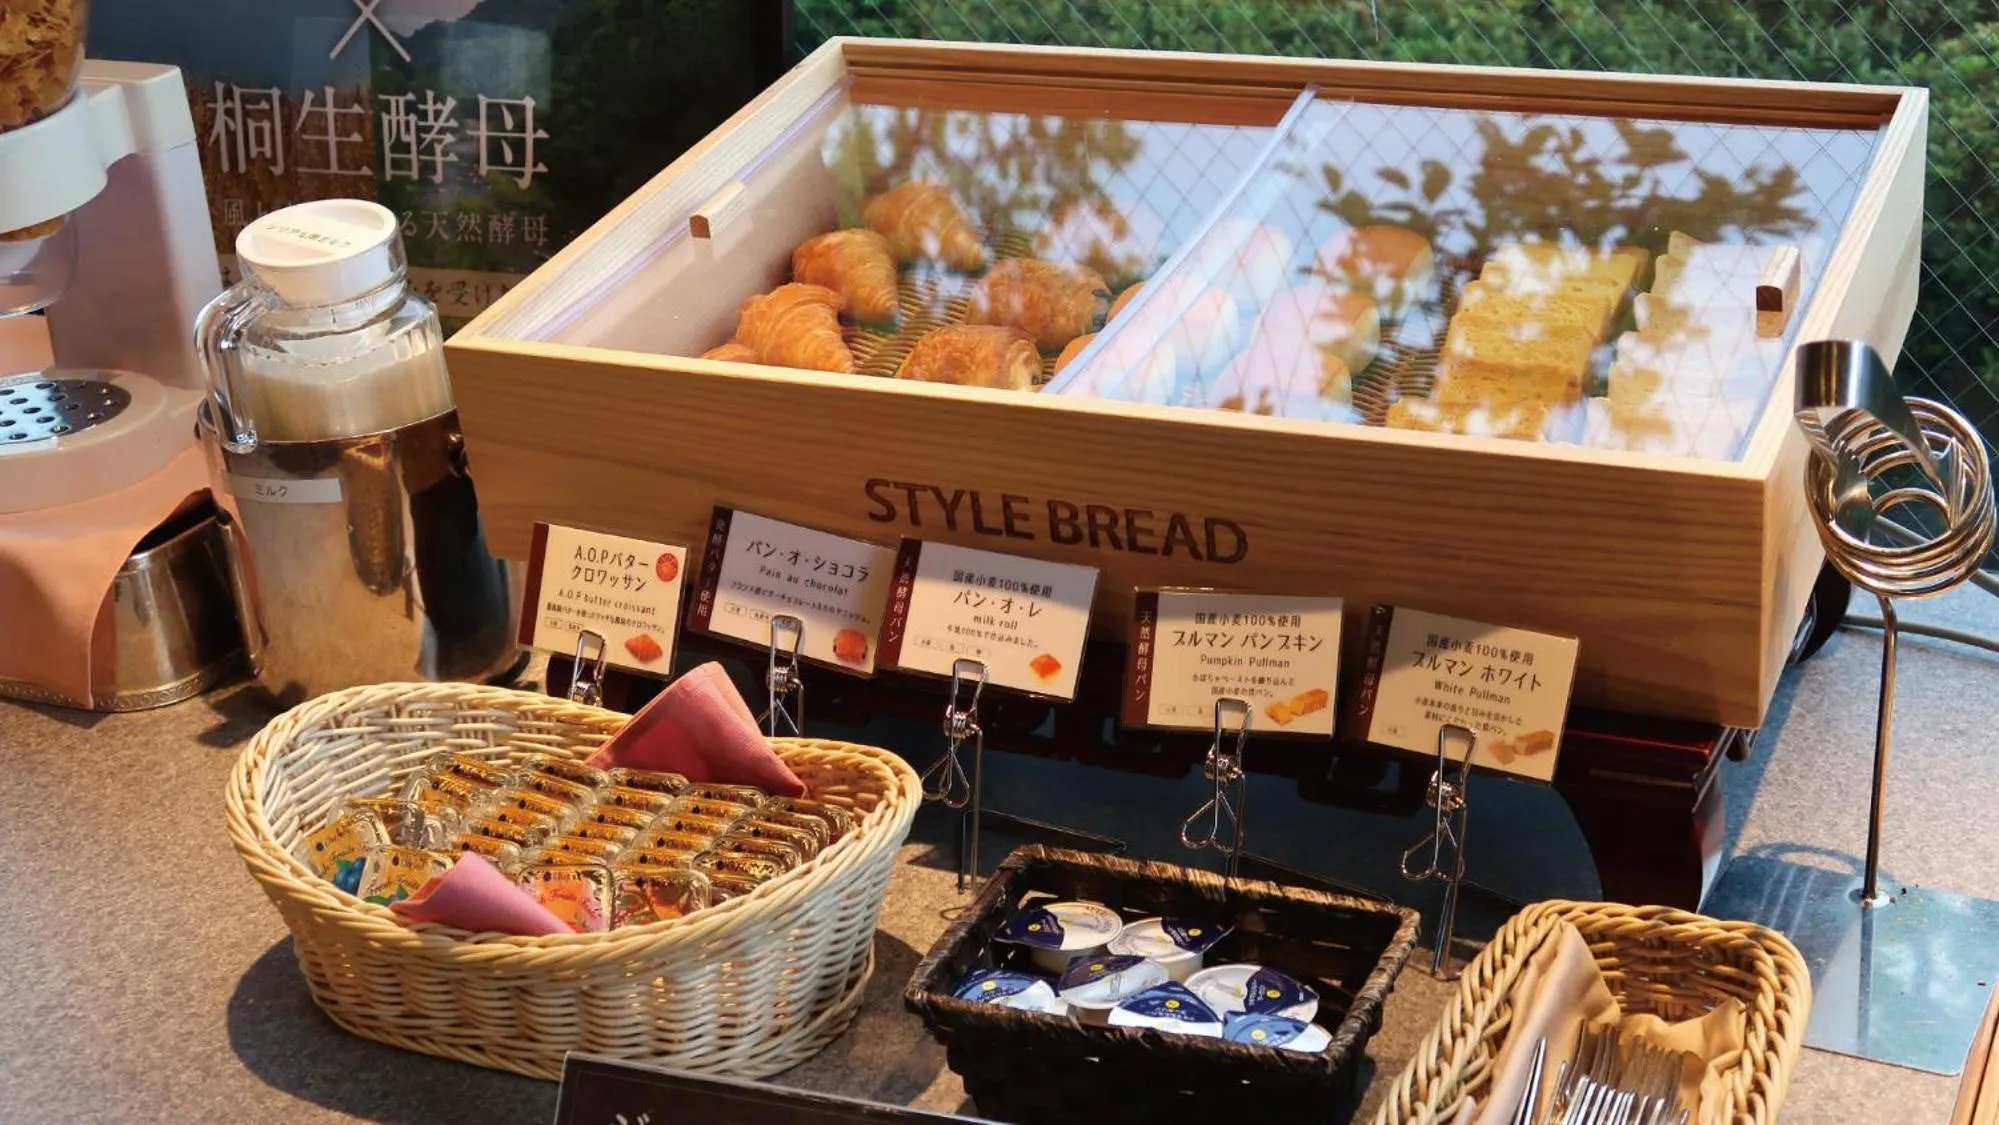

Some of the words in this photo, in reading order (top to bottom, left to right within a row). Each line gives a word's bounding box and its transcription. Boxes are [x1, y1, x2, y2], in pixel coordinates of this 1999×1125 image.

[206, 80, 551, 190] 桐生酵母
[254, 483, 288, 498] ミルク
[864, 477, 1035, 541] STYLE
[1046, 499, 1249, 565] BREAD
[745, 540, 870, 583] パン・オ・ショコラ
[759, 565, 781, 580] Pain
[786, 575, 800, 585] au
[571, 565, 647, 592] クロワッサン
[953, 569, 1053, 599] 国産小麦100%使用
[584, 593, 612, 607] butter
[614, 601, 656, 617] croissant
[952, 590, 1043, 618] パン・オ・レ
[973, 613, 996, 627] milk
[998, 618, 1018, 631] roll
[1194, 612, 1302, 628] 国産小麦100%使用
[1172, 629, 1235, 648] プルマン
[1240, 633, 1324, 652] パンプキン
[1426, 633, 1535, 666] 国産小麦100%使用
[1135, 610, 1152, 702] 天然酵母パン
[1200, 653, 1243, 667] Pumpkin
[1249, 655, 1290, 668] Pullman
[1411, 650, 1474, 677] プルマン
[1480, 665, 1542, 692] ホワイト
[1434, 680, 1464, 696] White
[1469, 686, 1511, 705] Pullman
